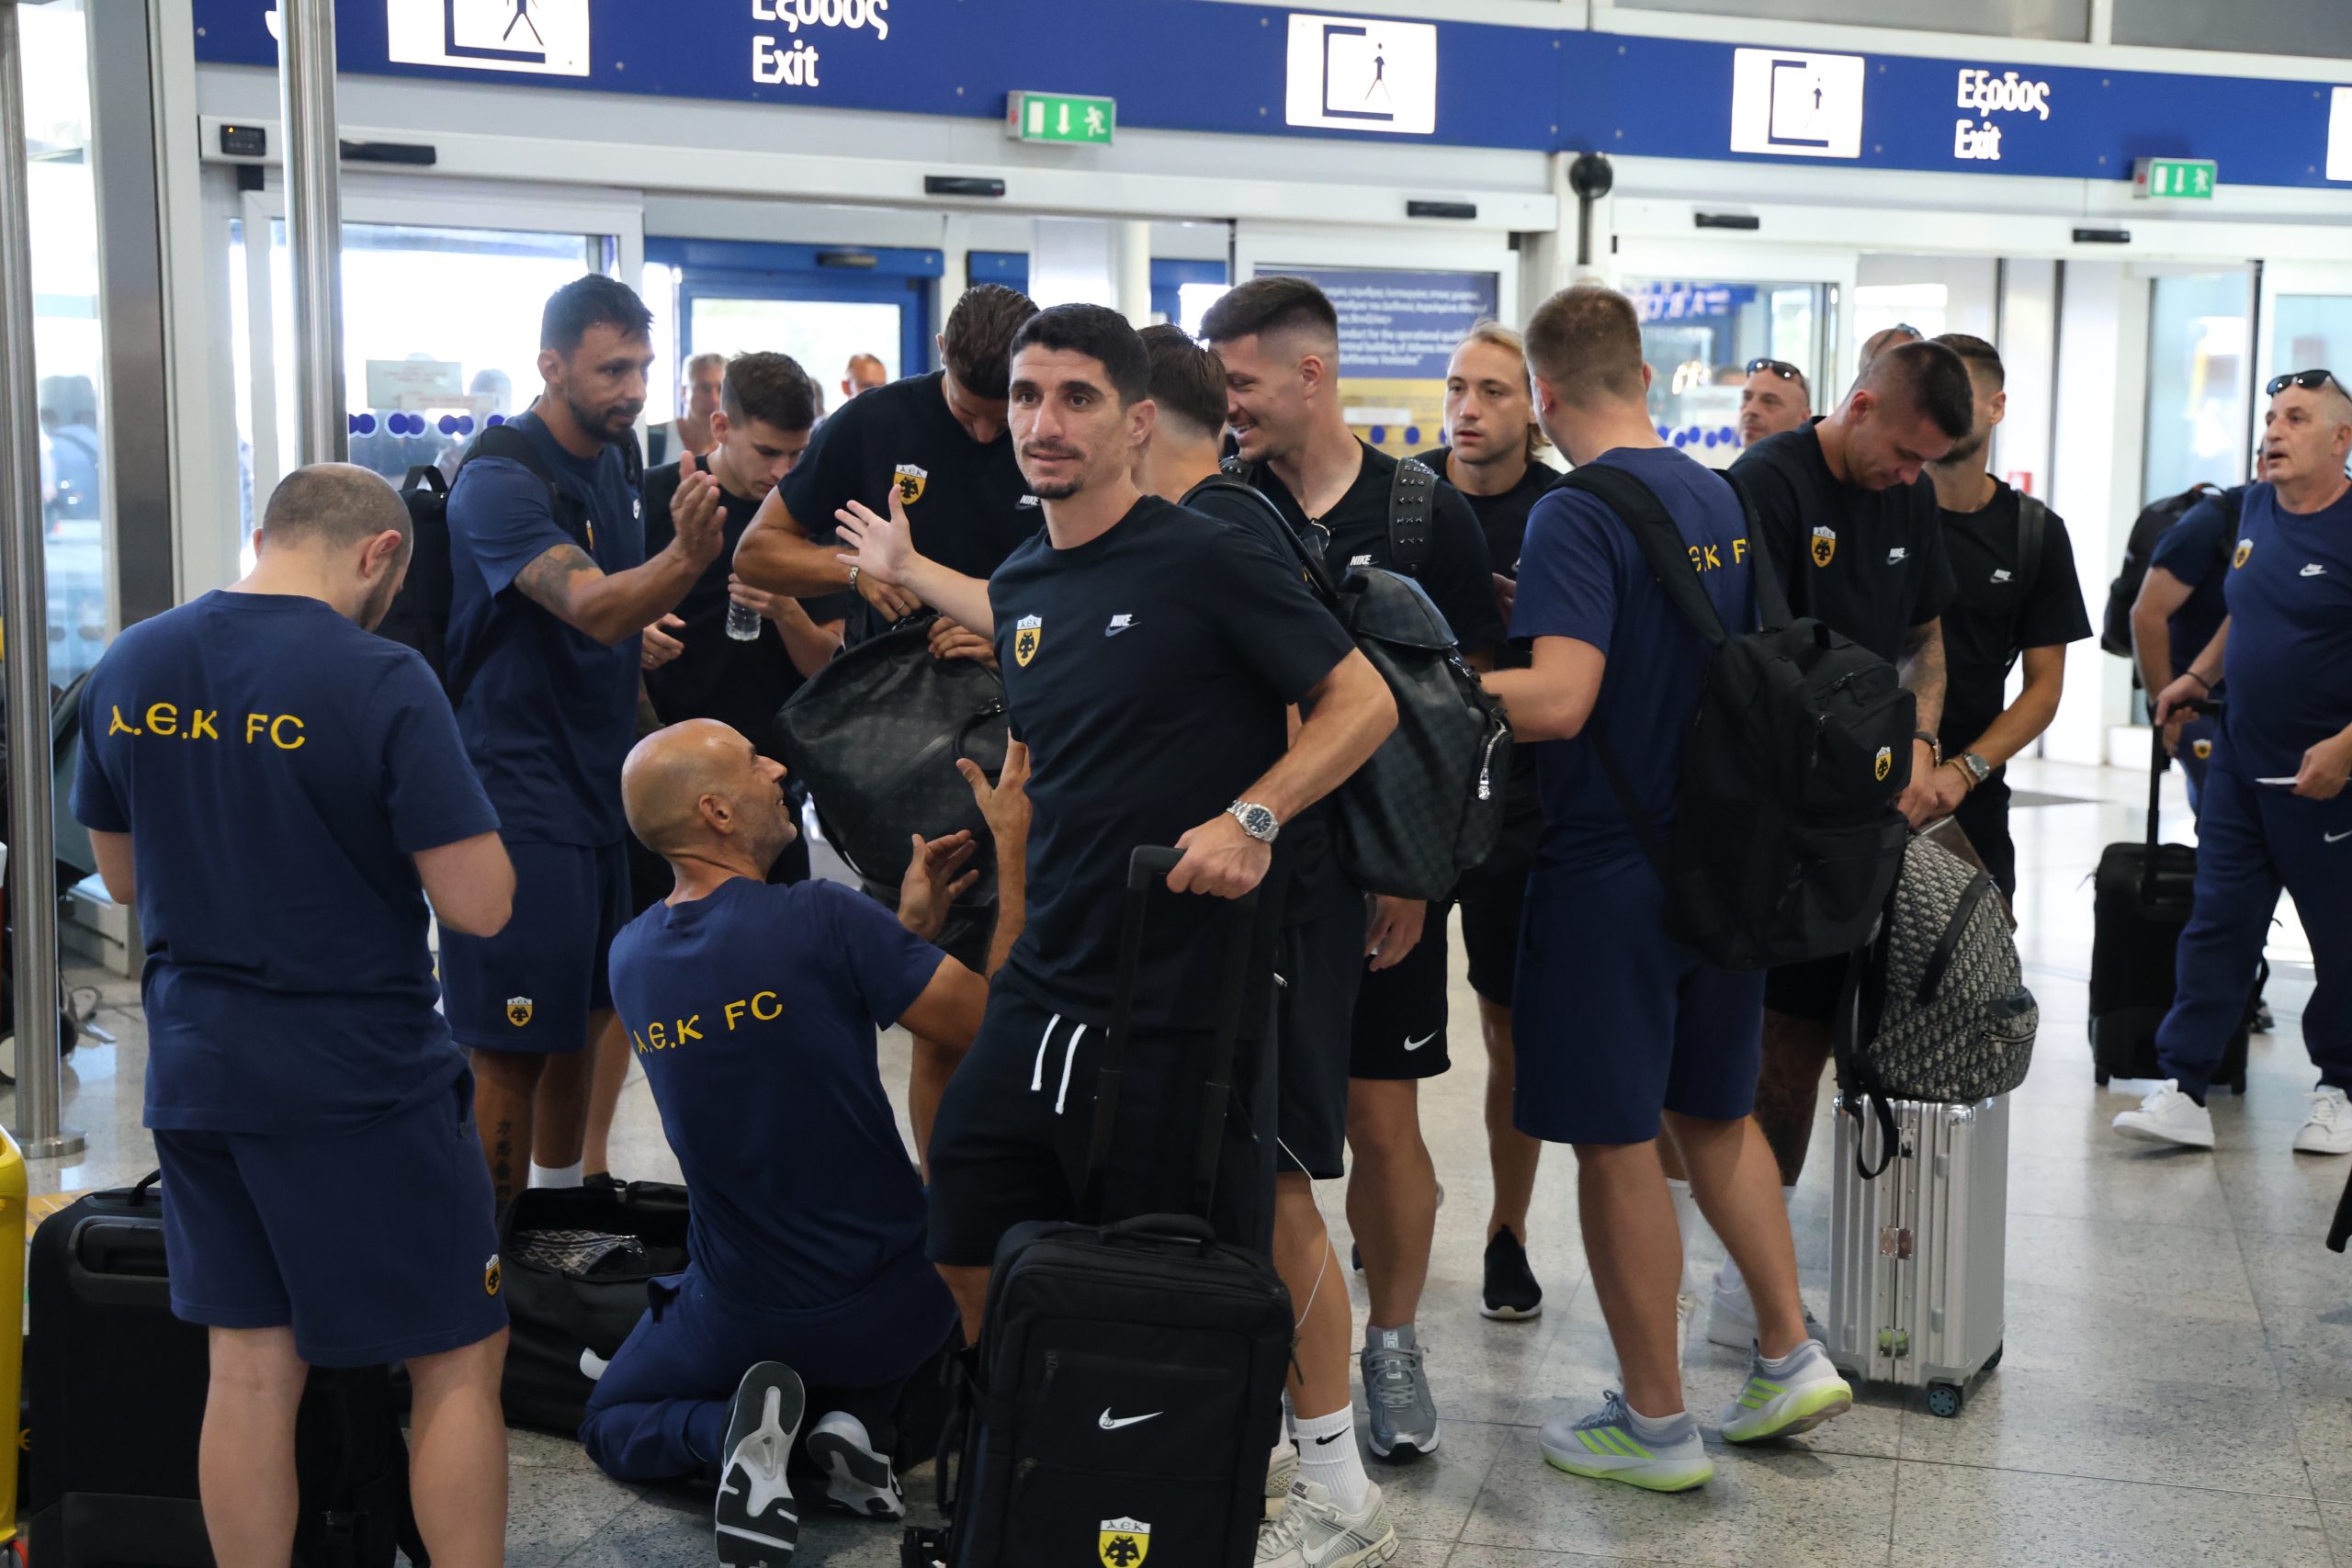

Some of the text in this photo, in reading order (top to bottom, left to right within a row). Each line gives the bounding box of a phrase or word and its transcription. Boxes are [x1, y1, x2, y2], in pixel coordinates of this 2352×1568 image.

[752, 35, 820, 87] Exit
[1953, 118, 2002, 161] Exit
[1019, 494, 1040, 506] NIKE
[1350, 554, 1373, 566] NIKE
[1732, 538, 1751, 564] F
[245, 713, 306, 750] FC
[724, 990, 783, 1031] FC
